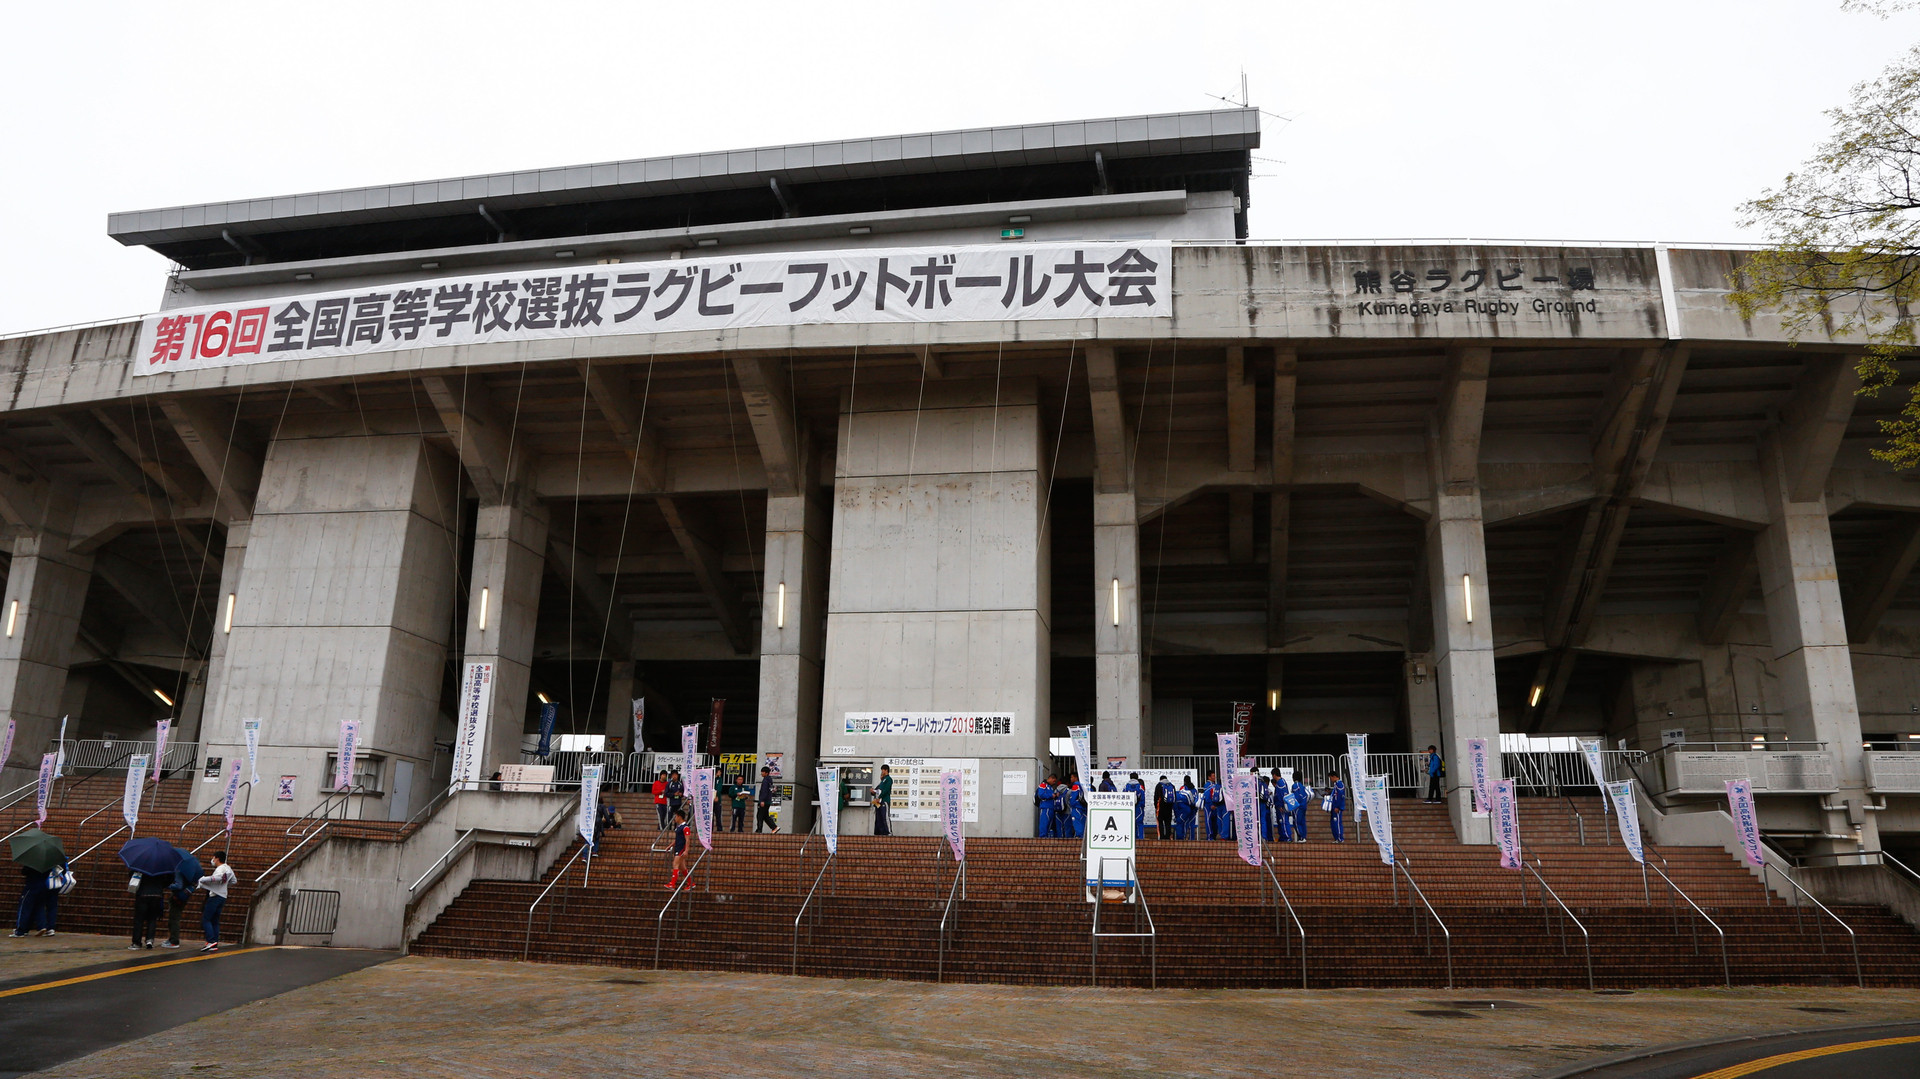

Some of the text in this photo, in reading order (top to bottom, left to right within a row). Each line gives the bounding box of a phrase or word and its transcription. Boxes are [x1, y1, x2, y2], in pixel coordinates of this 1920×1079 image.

[1354, 267, 1595, 294] 熊谷ラグビー場
[1360, 299, 1596, 317] Kumagaya Rugby Ground
[872, 716, 1011, 734] ラグビーワールドカップ2019熊谷開催
[722, 754, 757, 763] ラグビ
[1105, 816, 1118, 831] A
[1093, 834, 1130, 842] グラウンド
